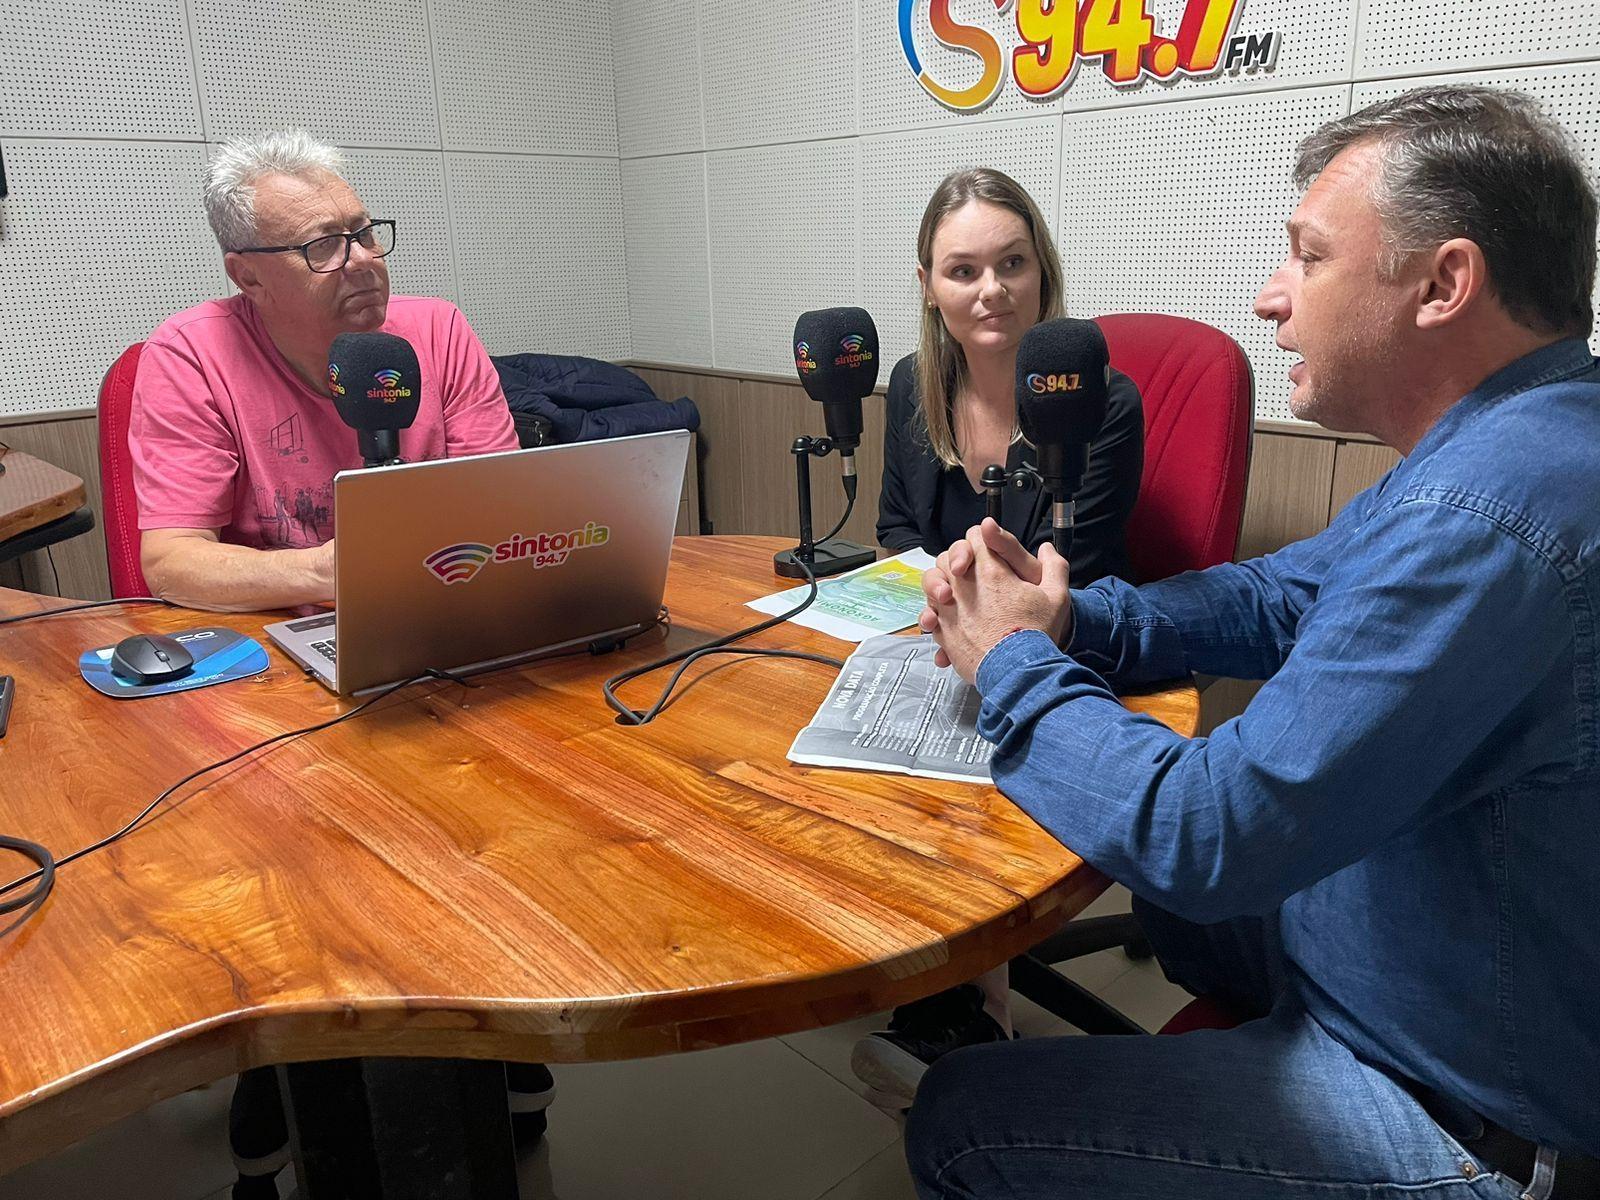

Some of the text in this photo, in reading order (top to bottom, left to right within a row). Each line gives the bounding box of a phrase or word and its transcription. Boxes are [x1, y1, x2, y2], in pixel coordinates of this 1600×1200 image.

[1224, 32, 1275, 70] FM
[367, 386, 412, 398] sintonia
[495, 522, 609, 561] sintonia
[536, 551, 568, 567] 94.7
[832, 670, 866, 709] NOVA DATA
